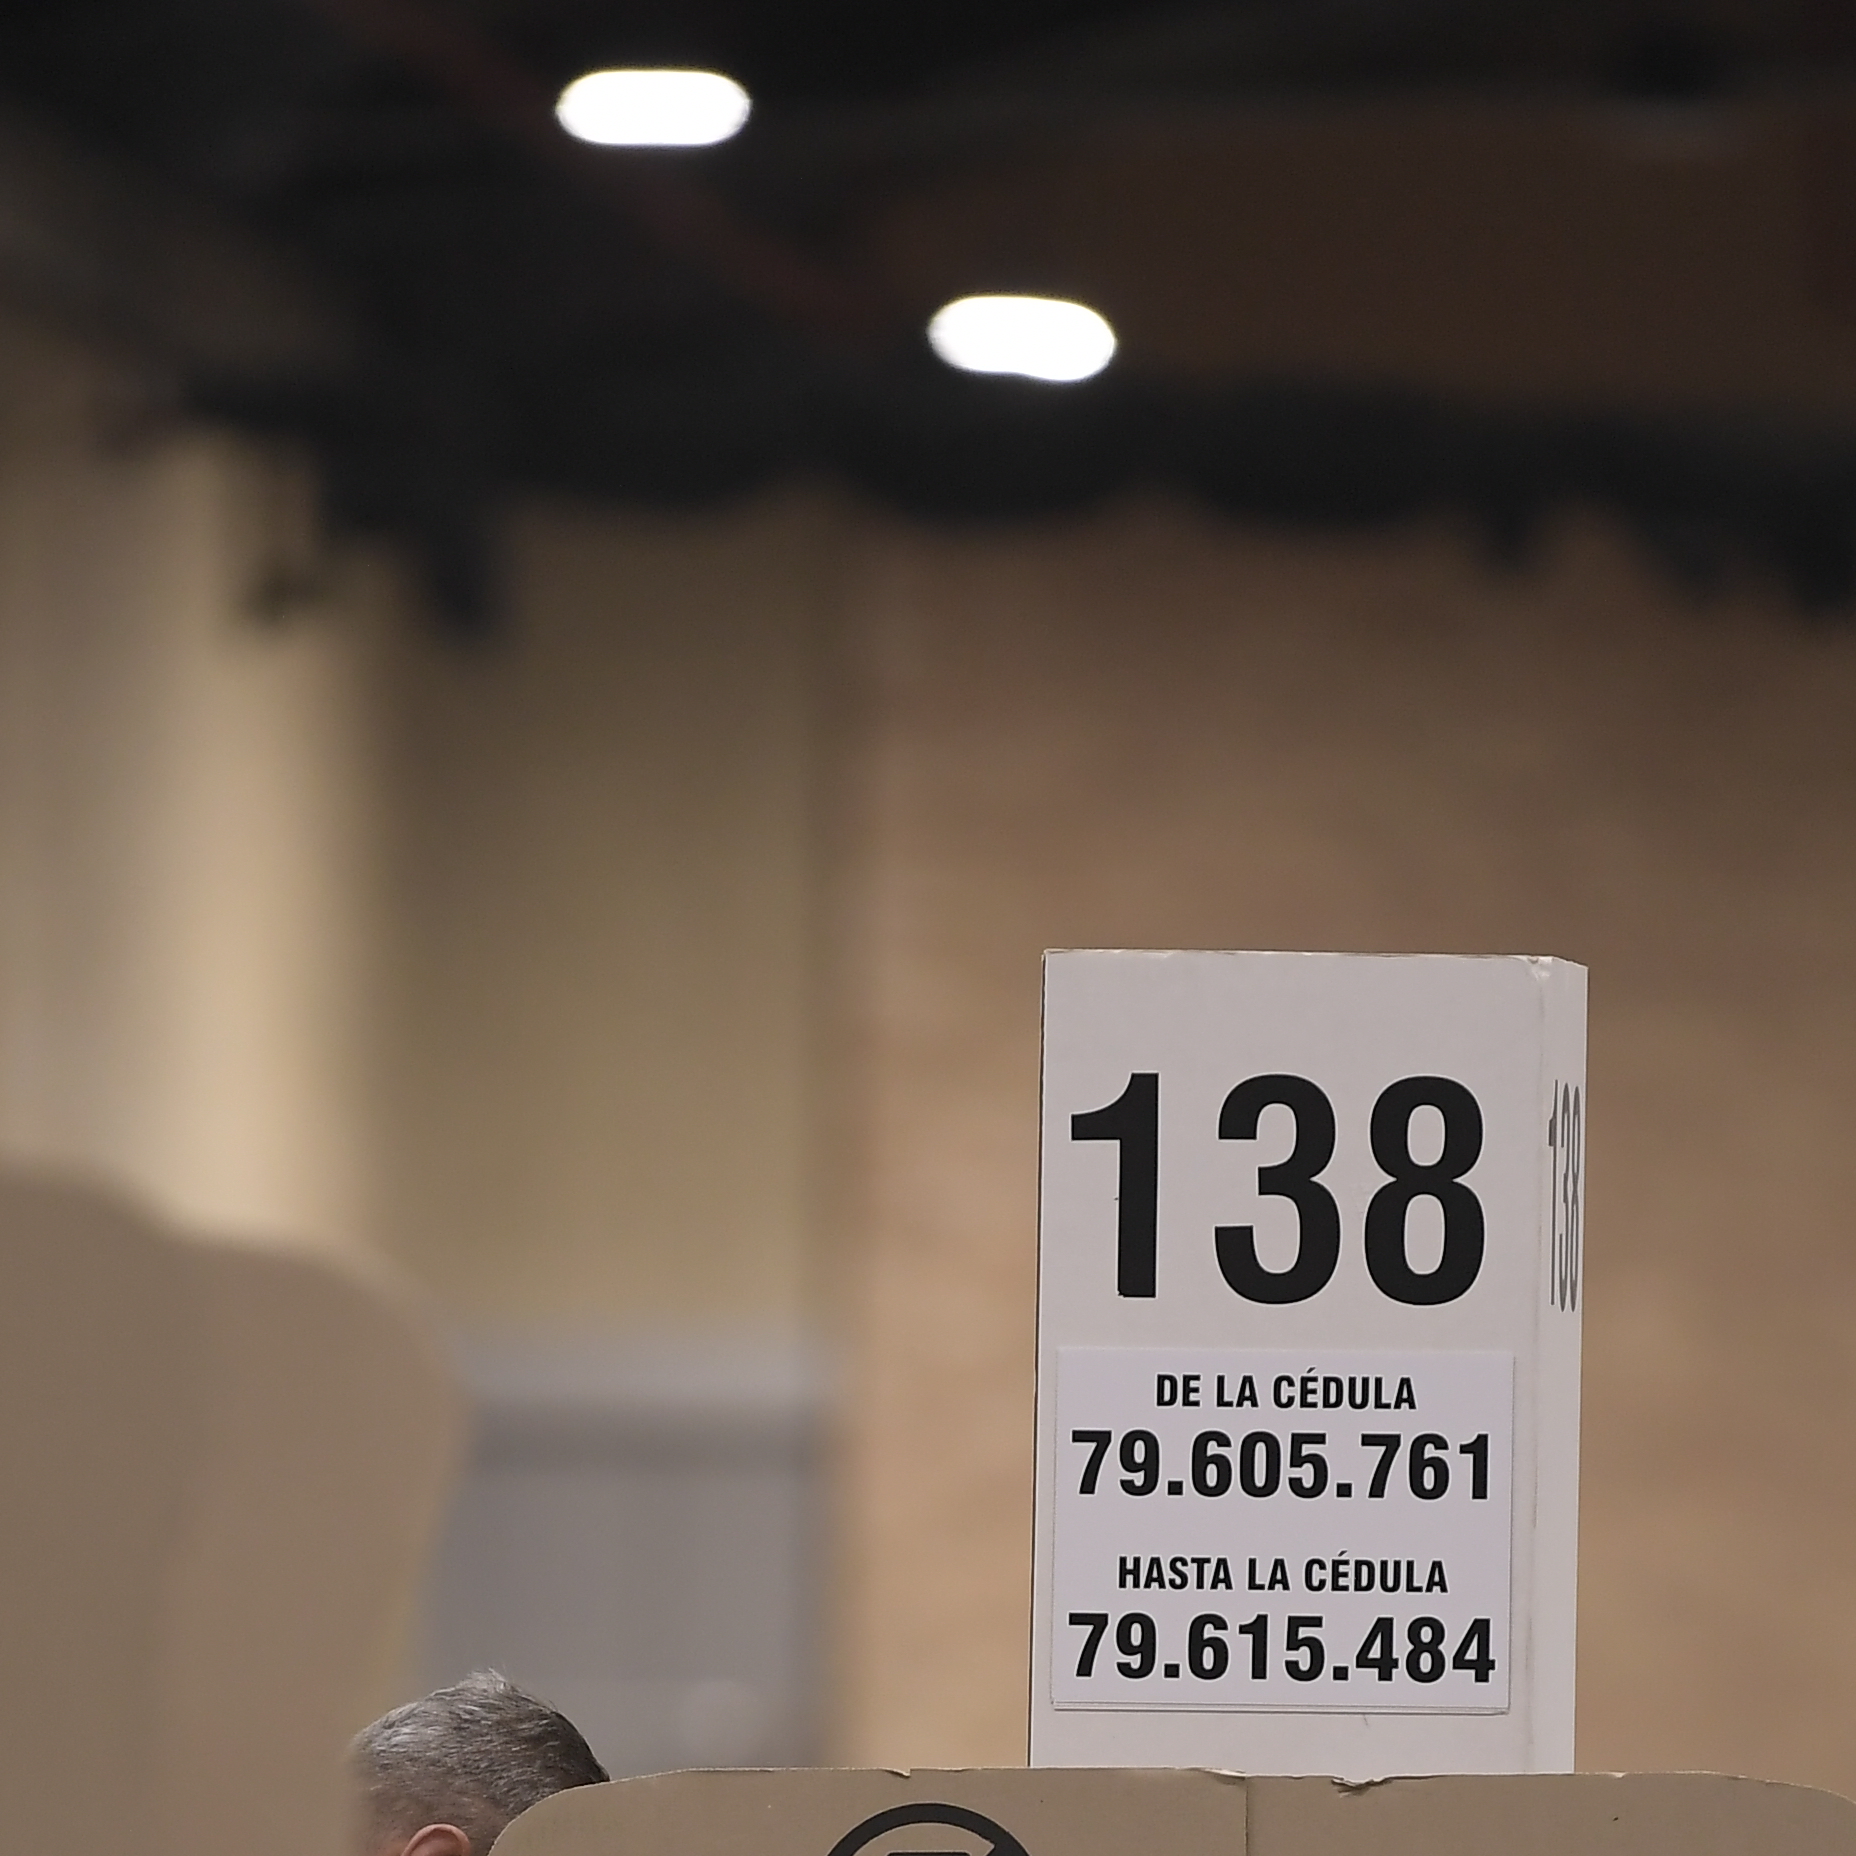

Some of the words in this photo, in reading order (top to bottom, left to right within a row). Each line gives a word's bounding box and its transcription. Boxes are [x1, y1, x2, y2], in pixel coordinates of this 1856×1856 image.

[1070, 1071, 1486, 1306] 138
[1548, 1079, 1581, 1312] 138
[1156, 1374, 1203, 1408] DE
[1215, 1374, 1259, 1409] LA
[1272, 1367, 1417, 1411] CÉDULA
[1070, 1429, 1490, 1501] 79.605.761
[1117, 1555, 1234, 1590] HASTA
[1247, 1557, 1291, 1592] LA
[1304, 1550, 1449, 1594] CÉDULA
[1067, 1611, 1496, 1683] 79.615.484
